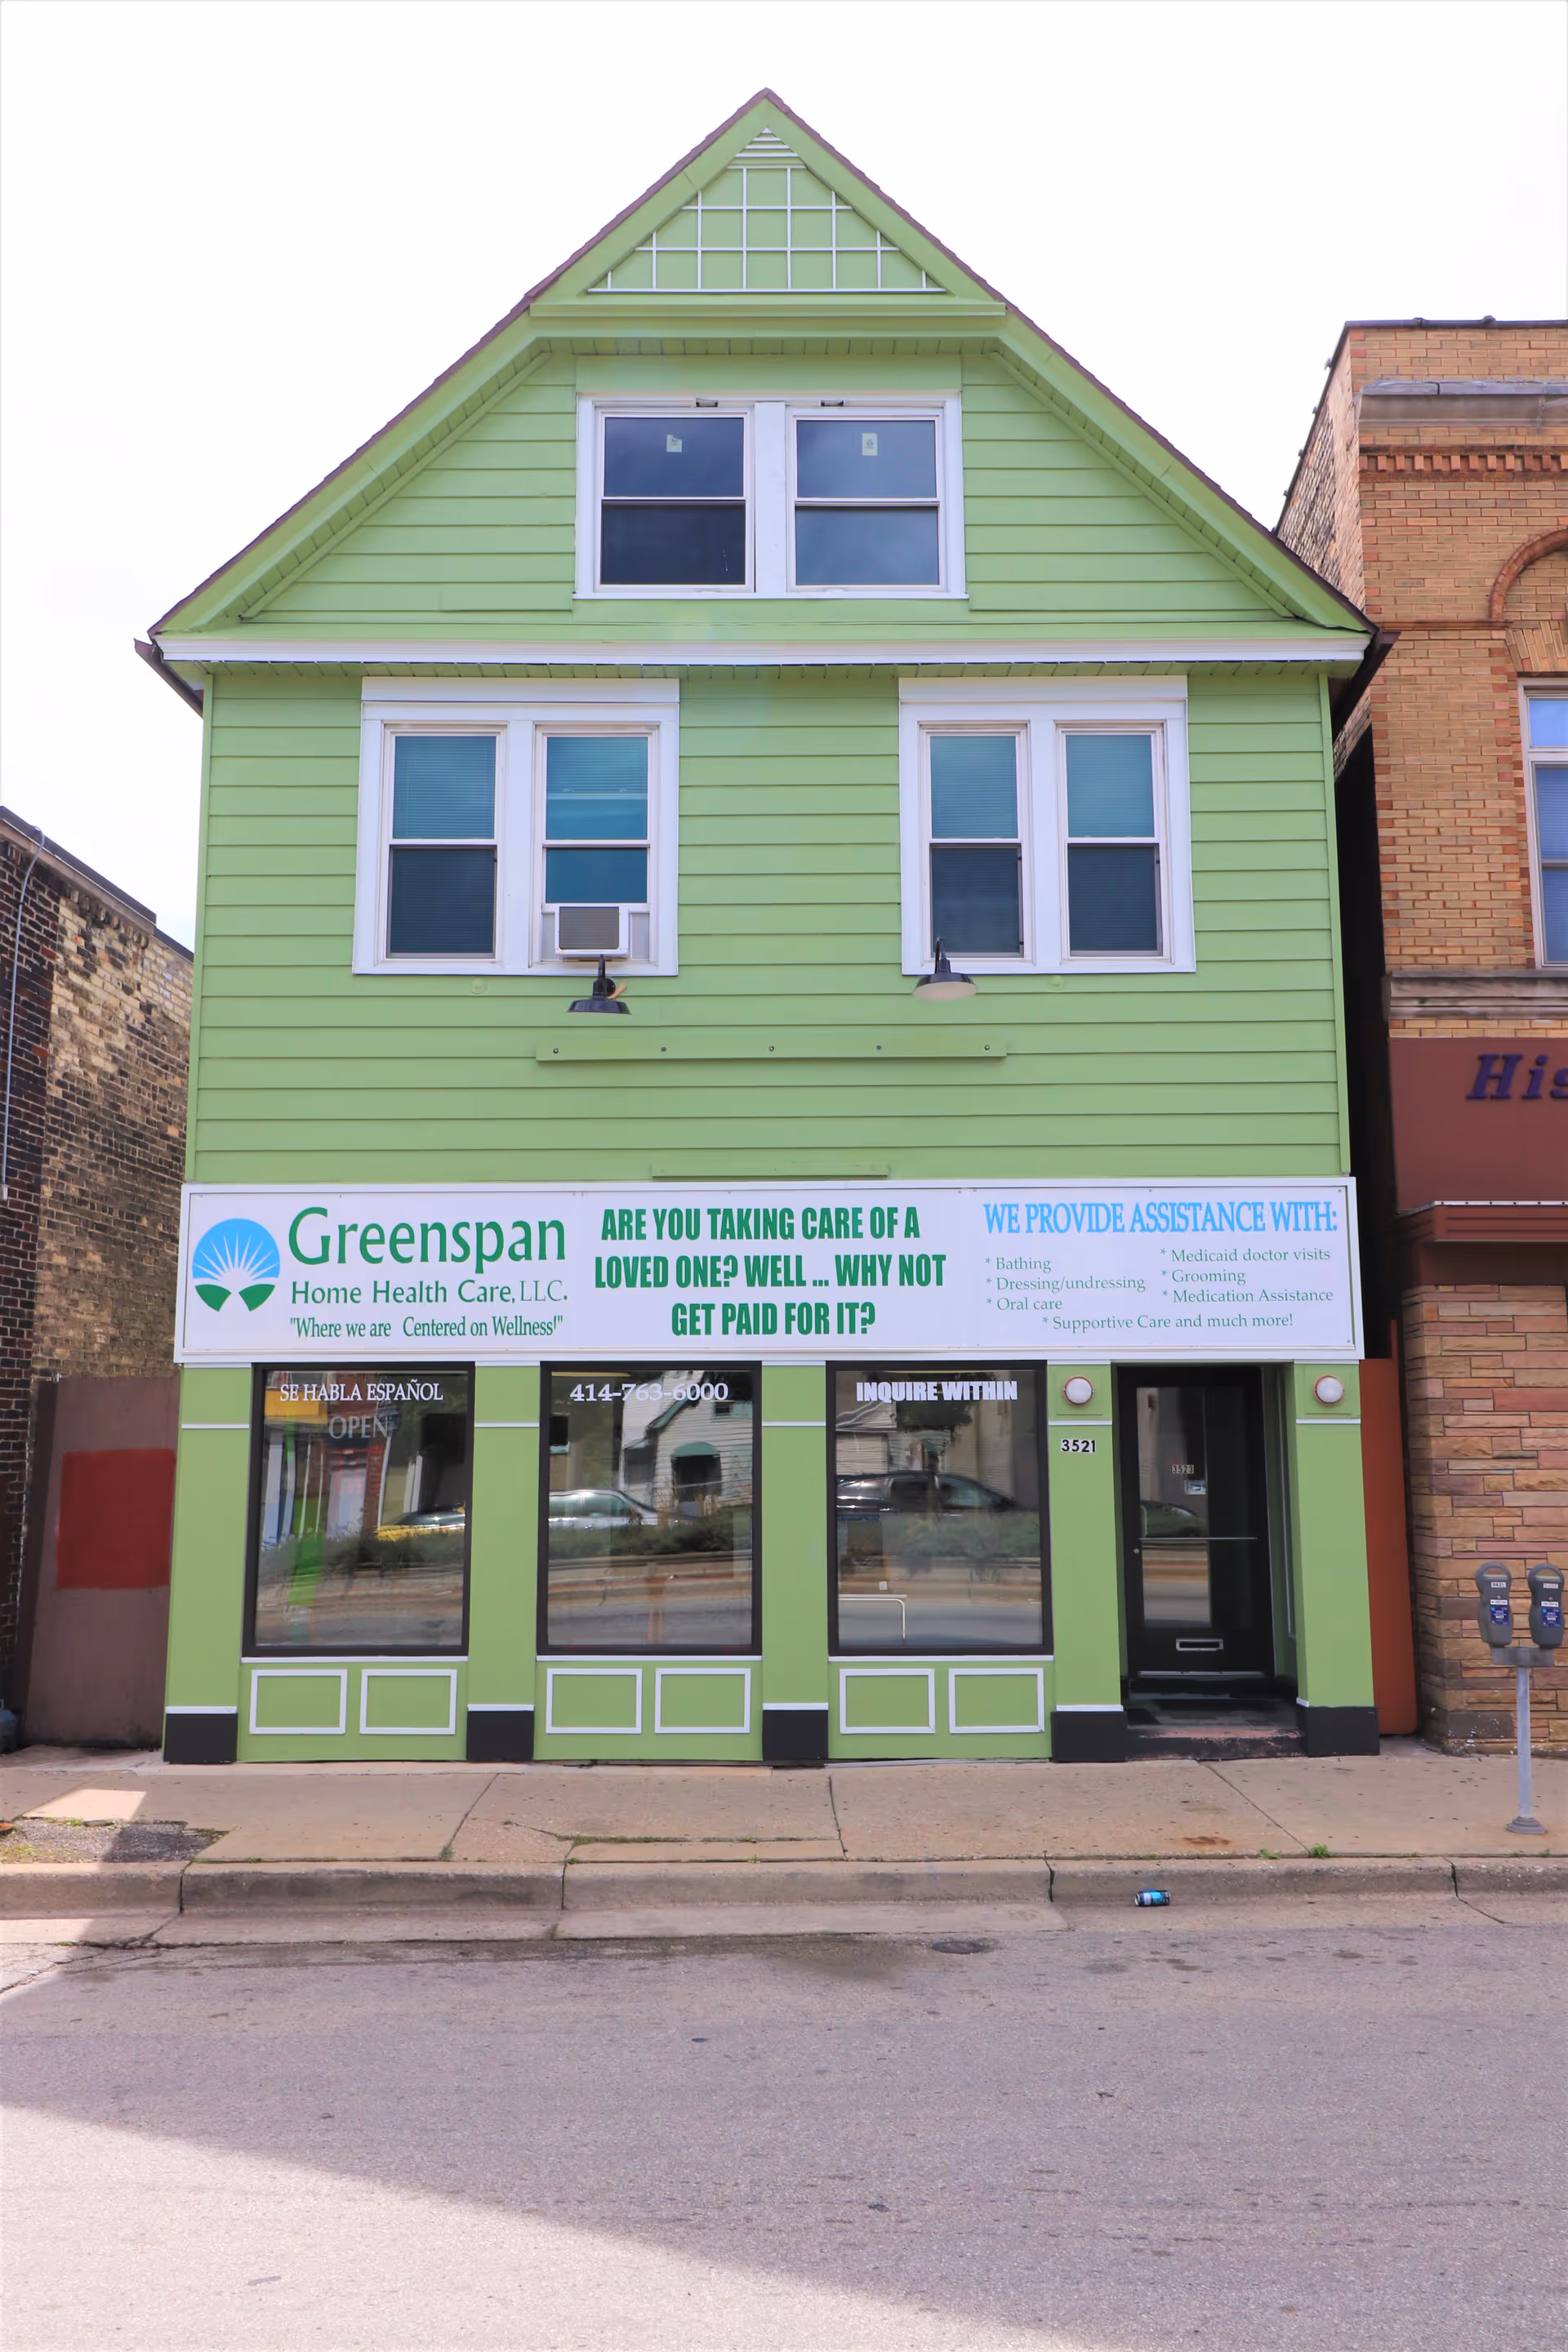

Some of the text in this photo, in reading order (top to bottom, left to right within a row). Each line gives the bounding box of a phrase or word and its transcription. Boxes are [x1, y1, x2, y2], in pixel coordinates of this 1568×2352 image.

[601, 1206, 920, 1241] ARE YOU TAKING CARE OF A
[983, 1201, 1337, 1233] WE PROVIDE ASSISTANCE WITH:
[288, 1206, 565, 1274] Greenspan
[996, 1257, 1051, 1273] Bathing
[1172, 1248, 1330, 1262] Medicaid doctor visits
[595, 1256, 668, 1289] LOVED
[675, 1254, 738, 1288] ONE?
[835, 1254, 892, 1286] WHY
[898, 1254, 947, 1286] NOT
[1172, 1269, 1245, 1285] Grooming
[292, 1280, 567, 1304] Home Health Care, LLC.
[996, 1276, 1145, 1293] Dressing/undressing
[997, 1297, 1062, 1310] Oral care
[1173, 1289, 1333, 1302] Medication Assistance
[291, 1315, 563, 1337] "Where we are Centered on Wellness!"
[672, 1302, 875, 1336] GET PAID FOR IT?
[1053, 1313, 1292, 1334] Supportive Care and much more!
[279, 1379, 443, 1402] SE HABLA ESPAÑOL
[569, 1383, 729, 1402] 414-763-6000
[857, 1381, 1017, 1403] INQUIRE WITHIN
[328, 1415, 389, 1439] OPEN
[1061, 1439, 1096, 1453] 3521
[1172, 1464, 1194, 1473] 3523
